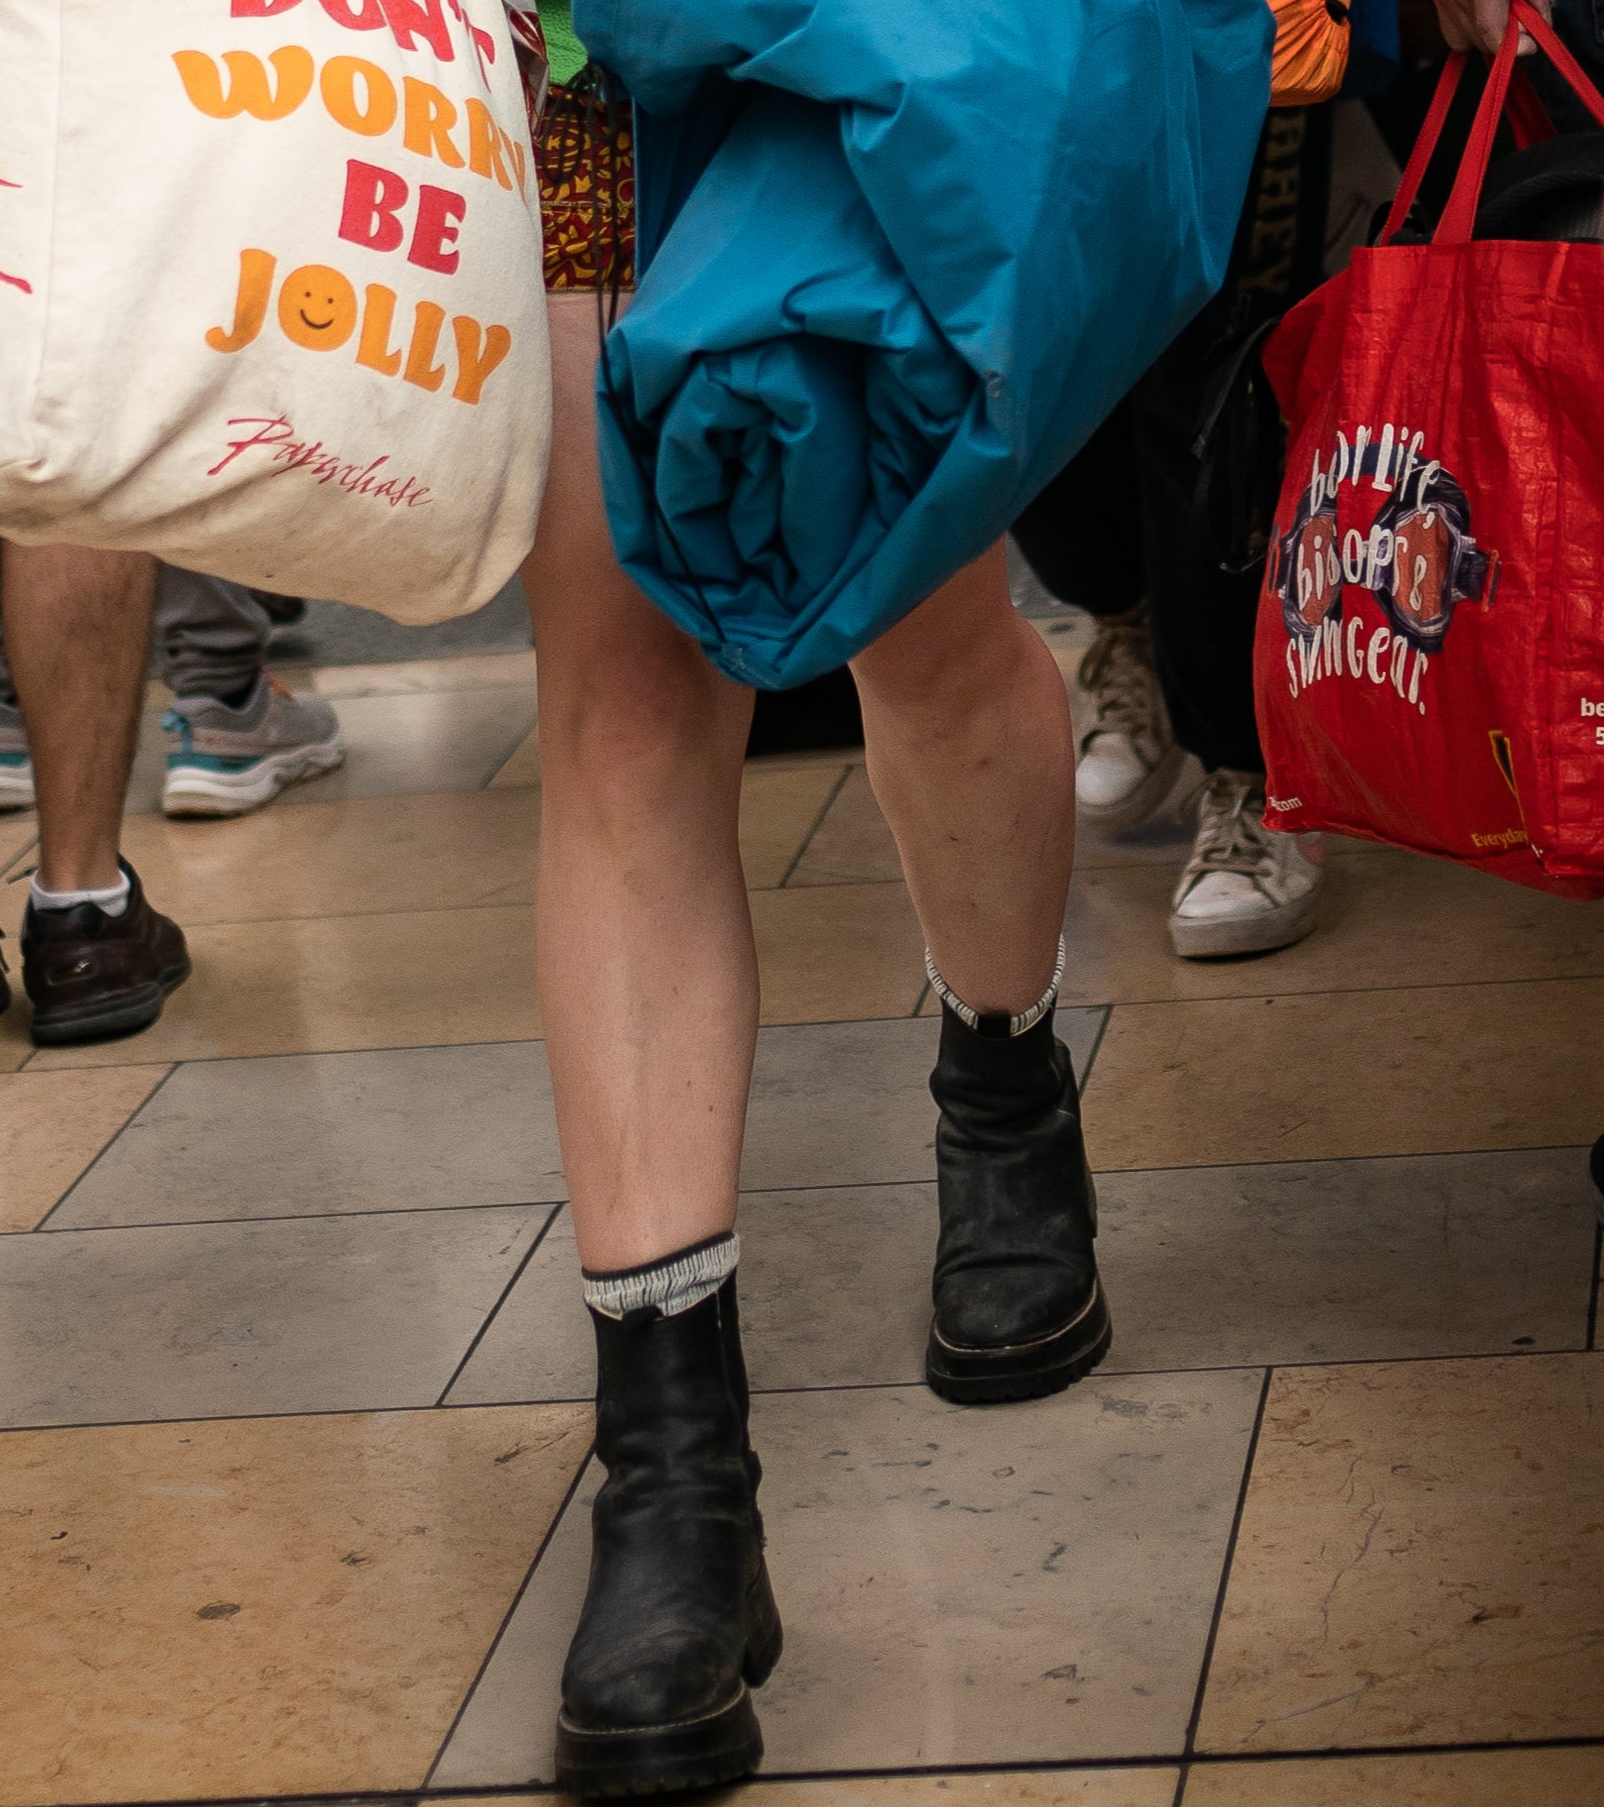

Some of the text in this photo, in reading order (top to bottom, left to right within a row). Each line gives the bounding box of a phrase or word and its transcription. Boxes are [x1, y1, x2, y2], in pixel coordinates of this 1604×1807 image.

[338, 158, 468, 275] BE
[203, 248, 513, 405] JOLLY
[205, 414, 436, 509] Paperchase
